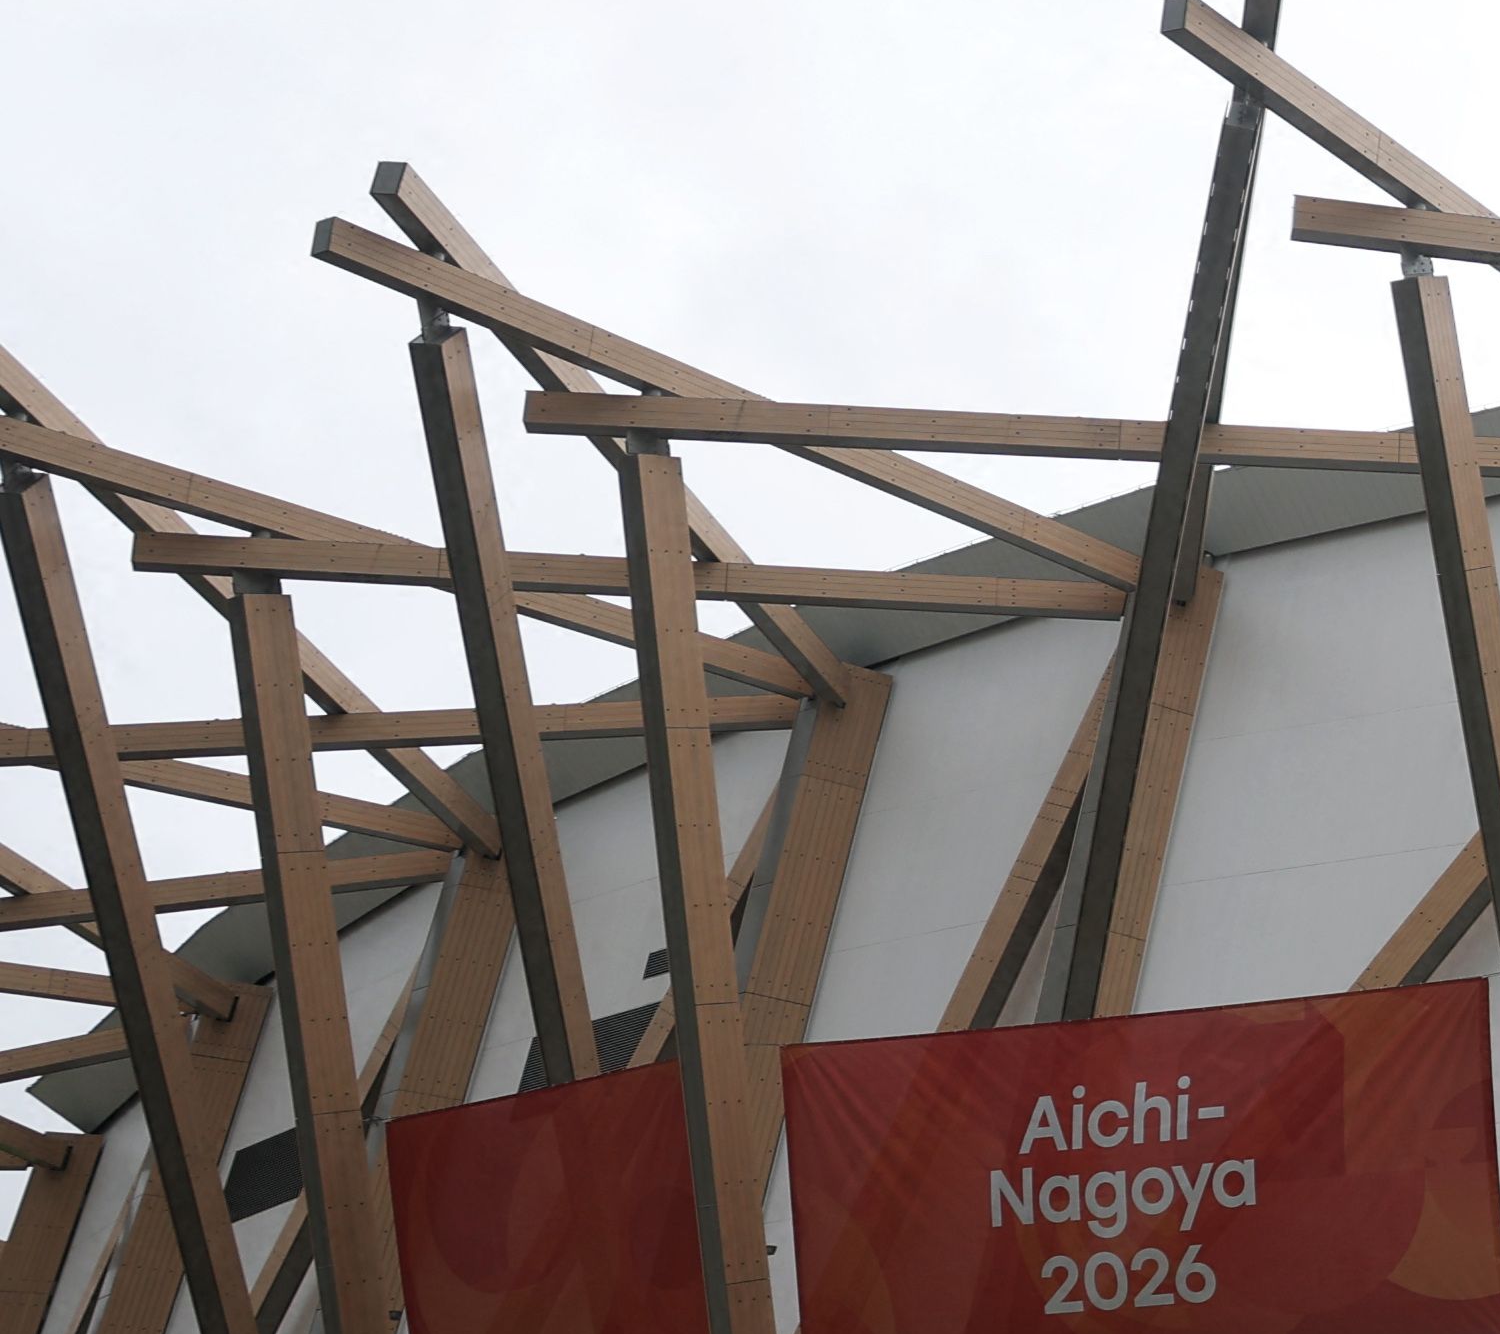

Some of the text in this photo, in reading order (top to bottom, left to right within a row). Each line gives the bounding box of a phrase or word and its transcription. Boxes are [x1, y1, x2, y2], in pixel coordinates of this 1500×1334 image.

[1019, 1075, 1226, 1155] Aichi-
[989, 1158, 1257, 1239] Nagoya
[1041, 1243, 1217, 1315] 2026
